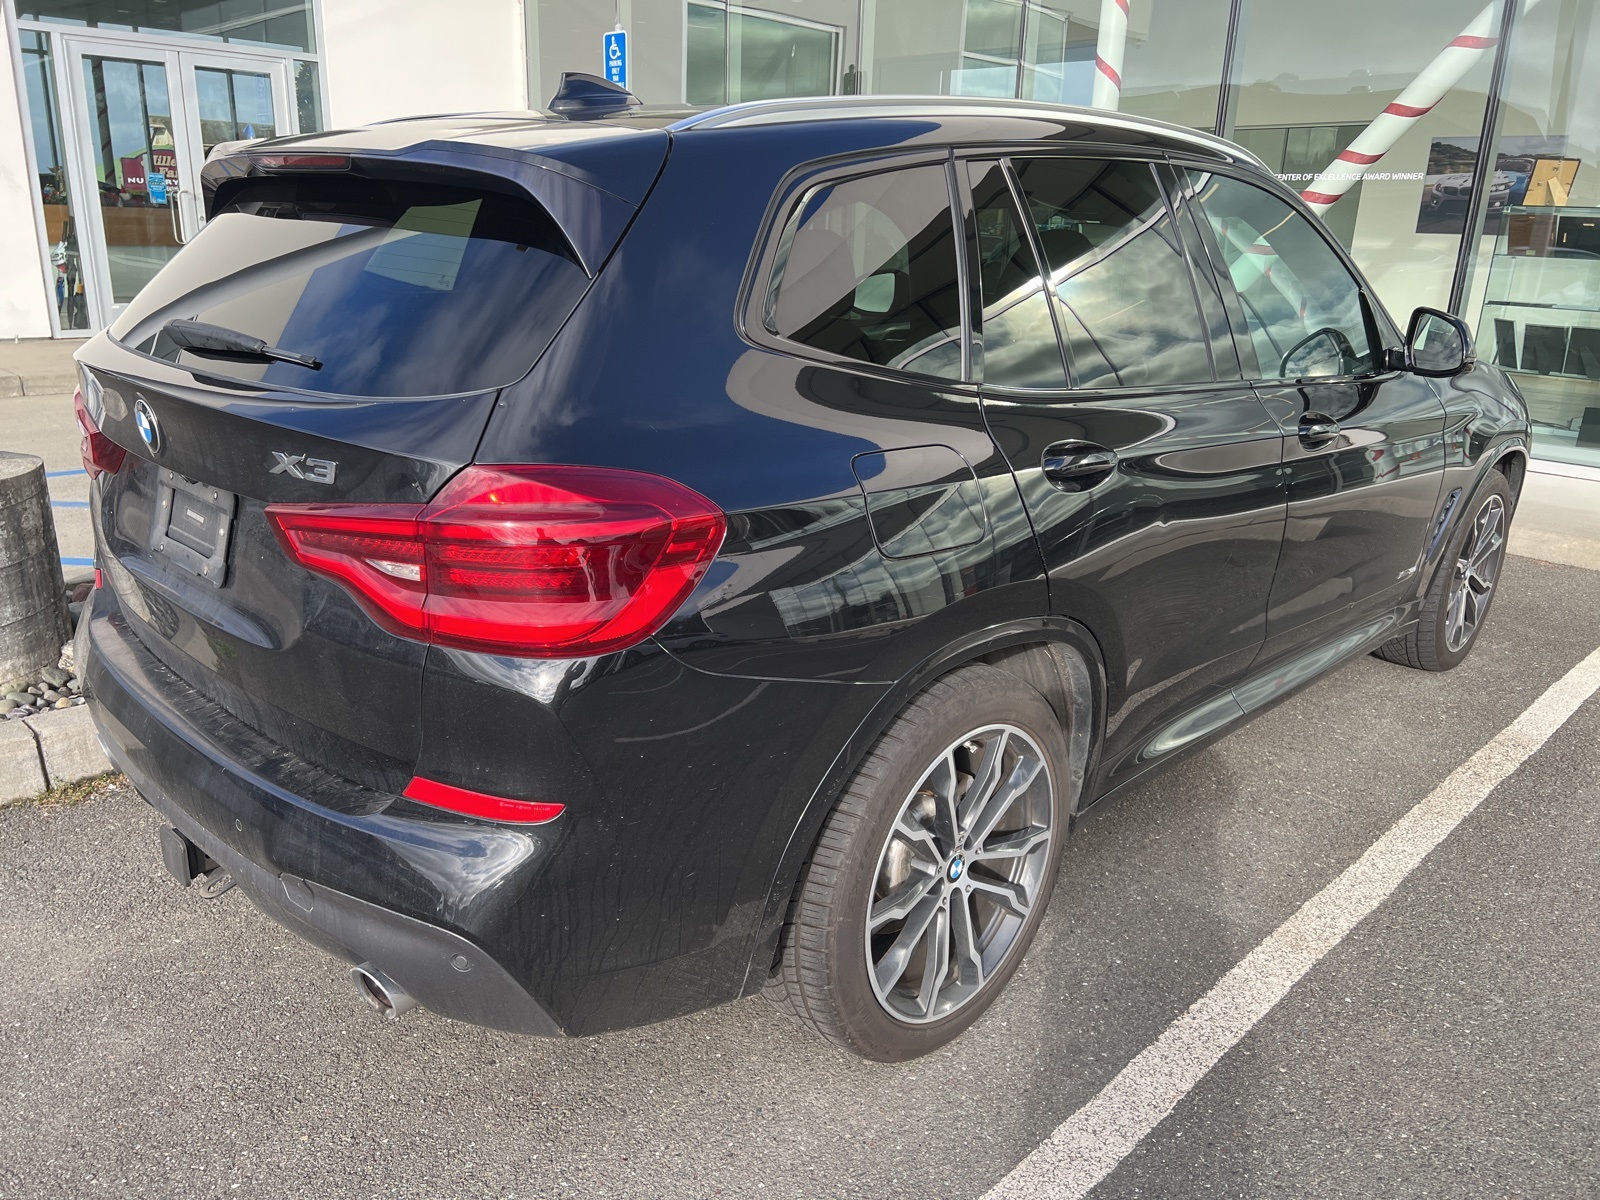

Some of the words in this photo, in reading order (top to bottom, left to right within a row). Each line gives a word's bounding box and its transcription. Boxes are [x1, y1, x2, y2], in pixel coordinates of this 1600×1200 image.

[1302, 173, 1313, 181] OF
[1314, 173, 1361, 181] EXCELLENCE
[1362, 172, 1391, 181] AWARD
[1392, 172, 1425, 181] WINNER
[268, 451, 338, 485] X3
